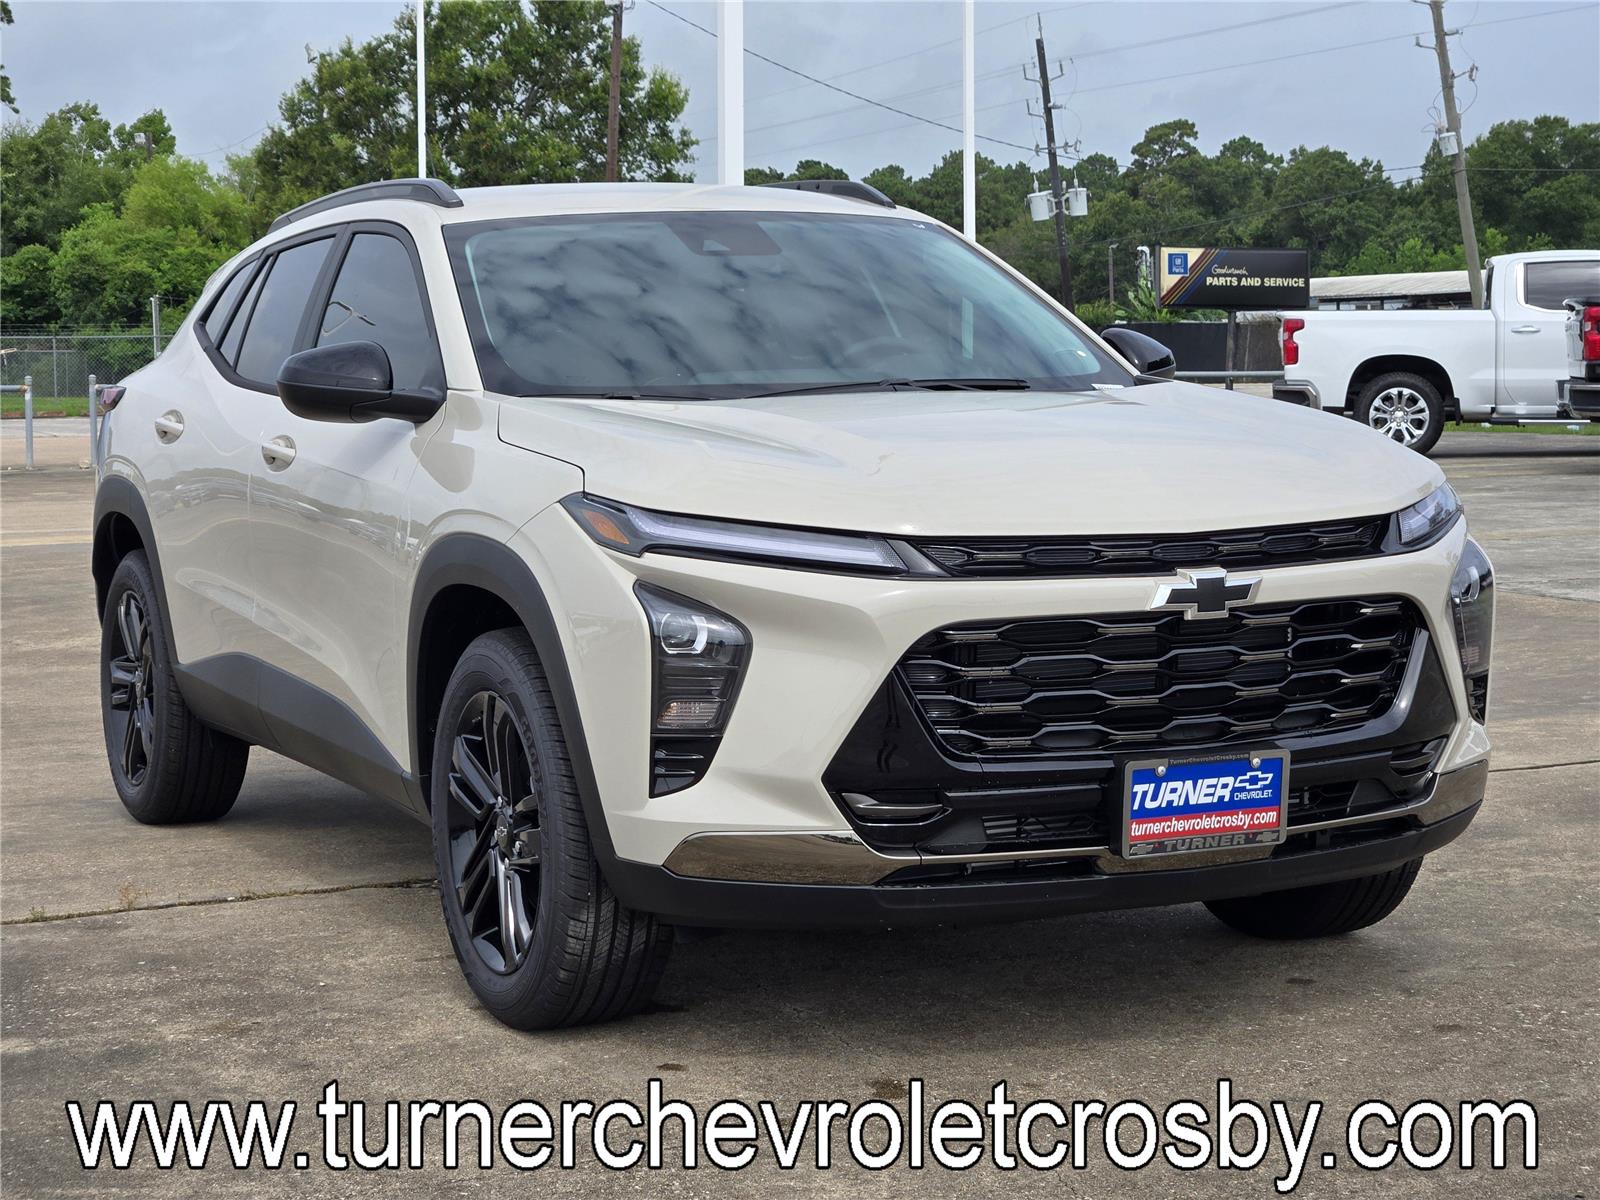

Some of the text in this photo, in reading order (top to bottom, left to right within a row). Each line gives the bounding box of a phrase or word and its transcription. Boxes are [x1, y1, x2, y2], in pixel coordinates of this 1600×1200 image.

[1206, 276, 1305, 287] PARTS AND SERVICE
[1132, 776, 1235, 811] TURNER
[1234, 789, 1273, 801] CHEVROLET
[1131, 810, 1277, 837] turnerchevroletcrosby.com
[1164, 833, 1247, 852] TURNER
